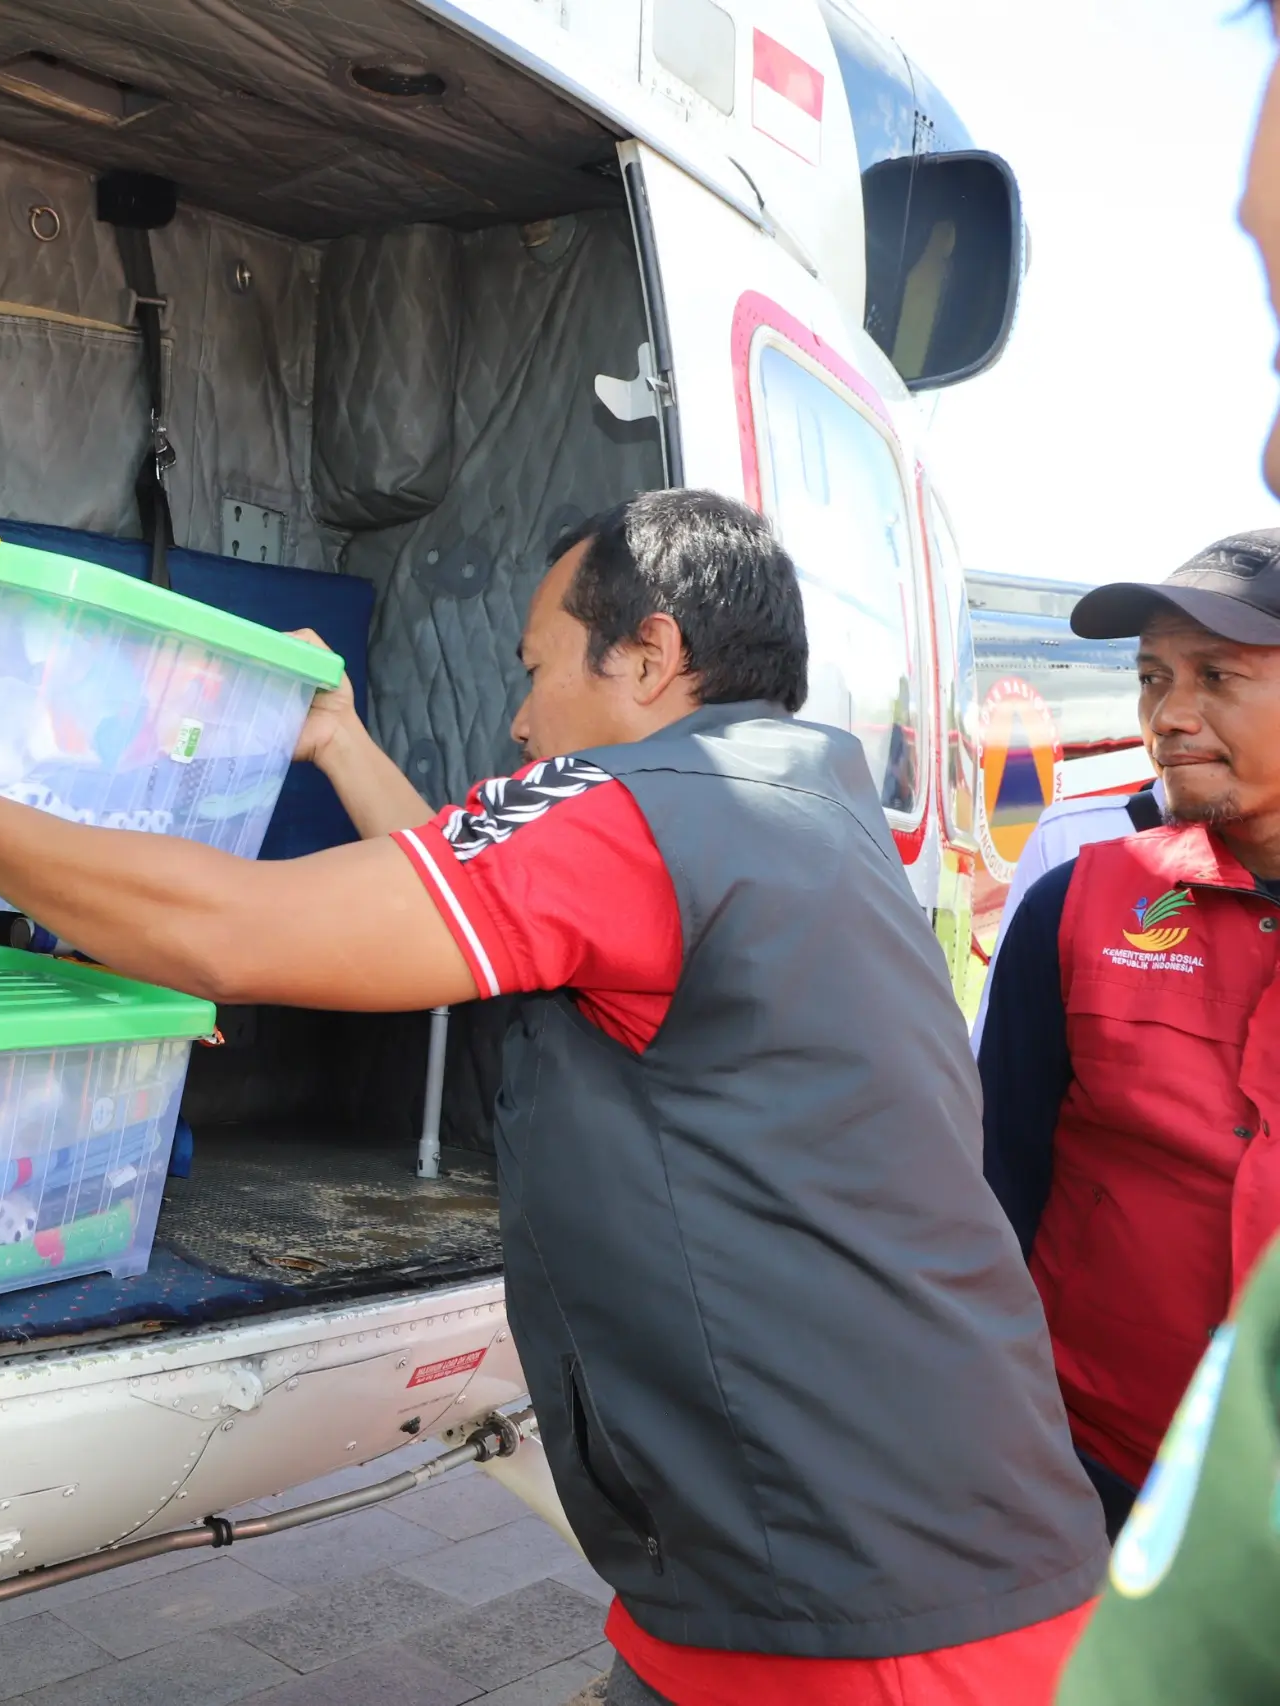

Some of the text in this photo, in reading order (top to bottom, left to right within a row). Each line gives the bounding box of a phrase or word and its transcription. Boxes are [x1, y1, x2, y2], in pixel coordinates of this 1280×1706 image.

[1102, 948, 1204, 967] KEMENTERIAN SOSIAL
[1111, 957, 1194, 973] REPUBLIK INDONESIA
